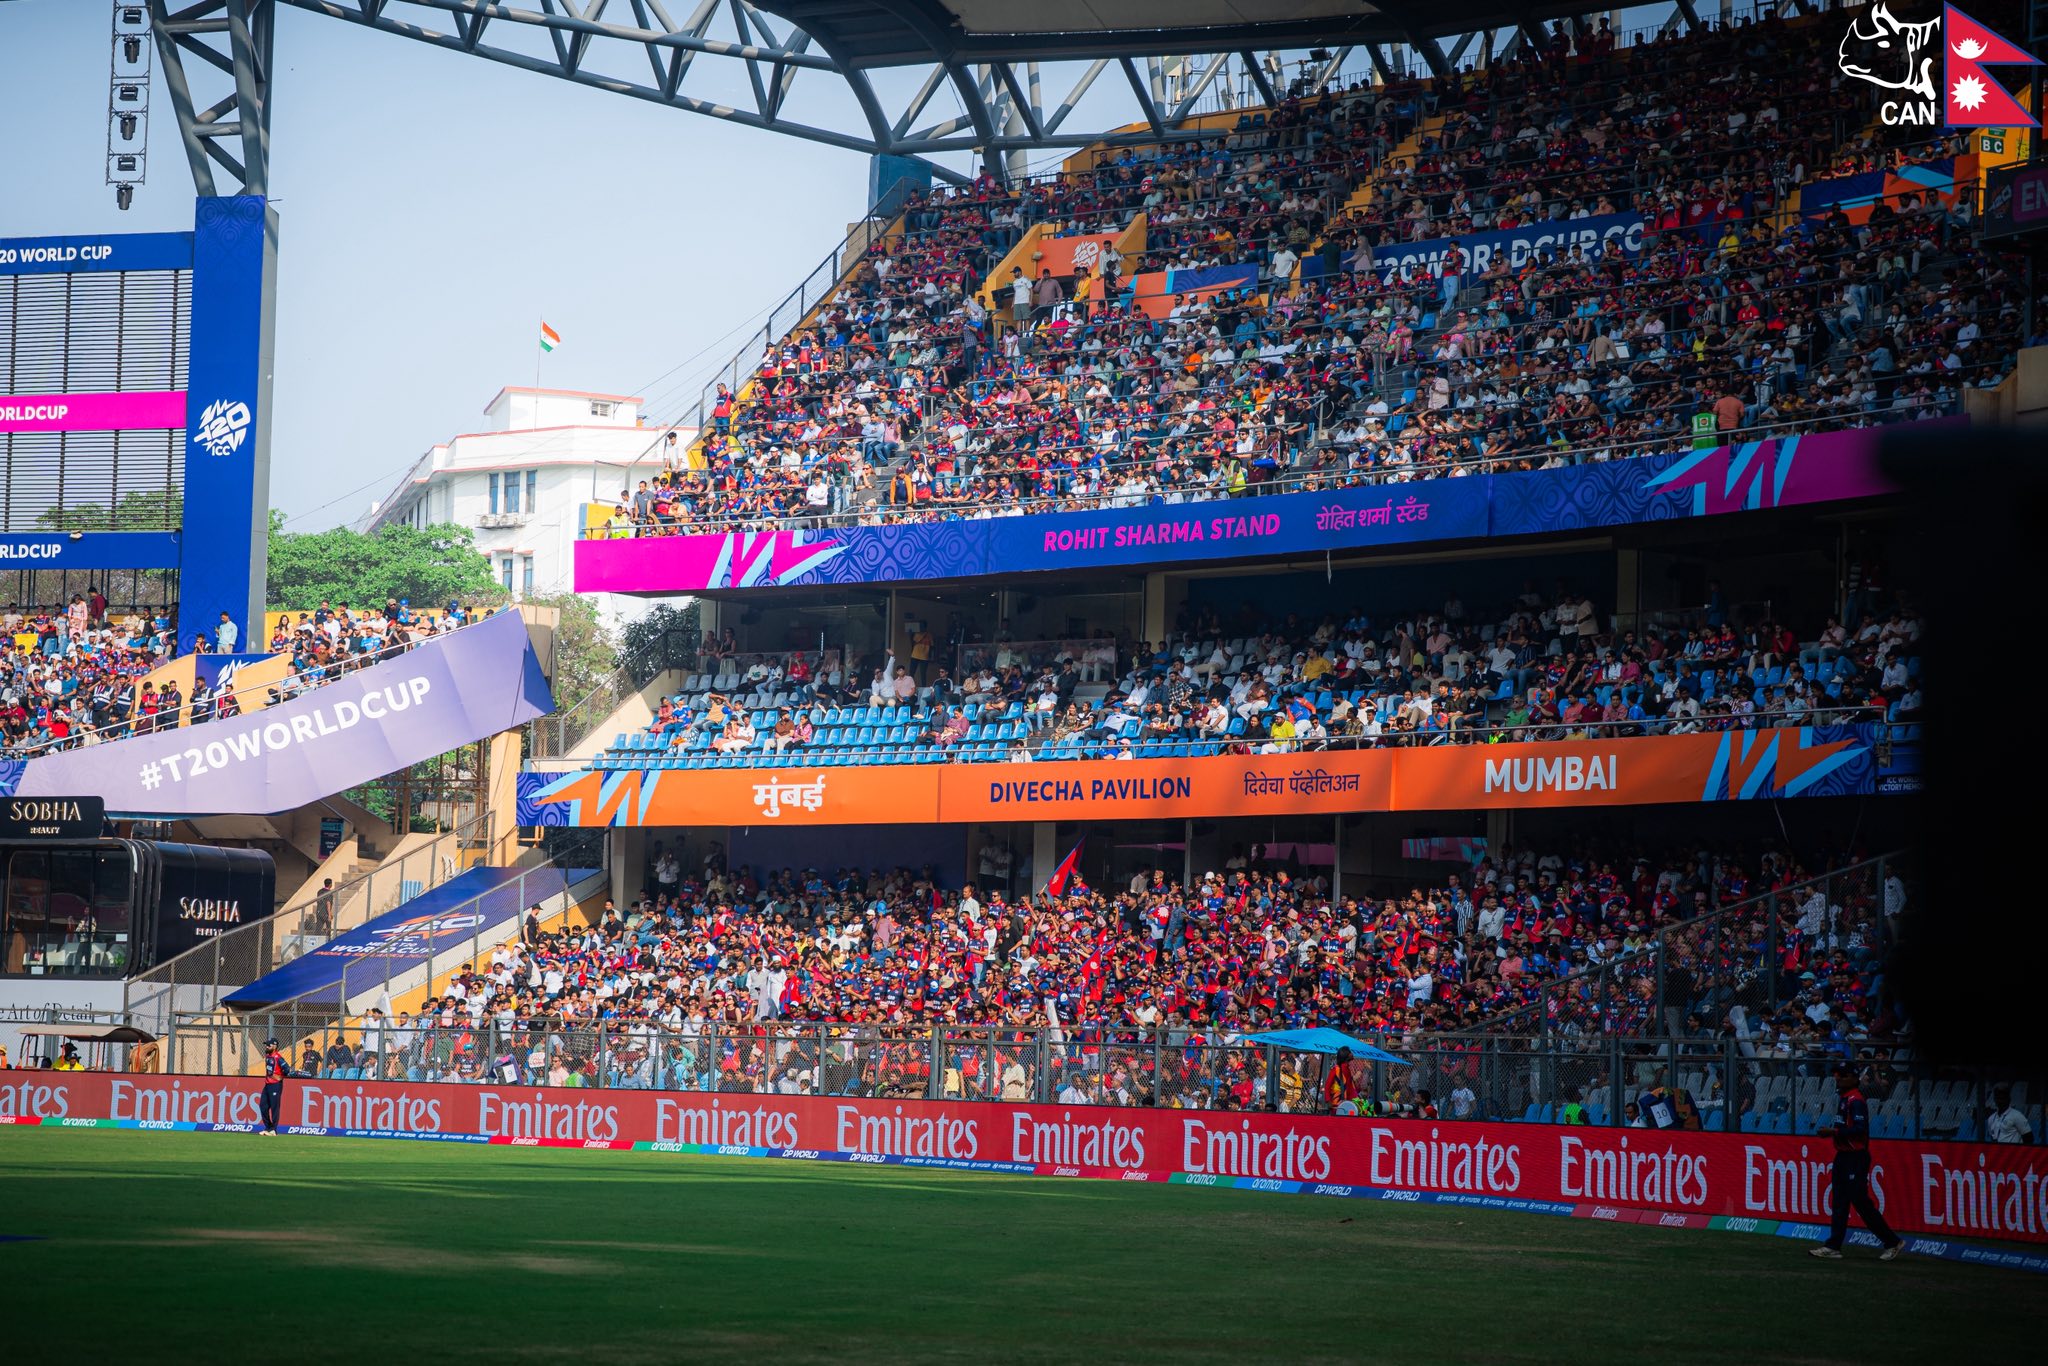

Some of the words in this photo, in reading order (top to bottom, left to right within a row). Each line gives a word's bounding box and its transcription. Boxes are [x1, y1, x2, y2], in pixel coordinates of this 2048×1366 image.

[1982, 139, 1990, 151] B
[1994, 140, 2002, 153] C
[20, 247, 76, 262] WORLD
[81, 246, 112, 260] CUP
[212, 446, 230, 456] ICC
[1316, 504, 1357, 531] रोहित
[1358, 498, 1392, 526] शर्मा
[1044, 528, 1109, 552] ROHIT
[1115, 520, 1204, 547] SHARMA
[1210, 514, 1280, 540] STAND
[139, 676, 430, 790] #T20WORLDCUP
[1484, 755, 1617, 793] MUMBAI
[991, 780, 1084, 803] DIVECHA
[1092, 777, 1191, 800] PAVILION
[1244, 771, 1284, 796] दिवेचा
[753, 774, 825, 817] मुंबई
[10, 801, 82, 822] SOBHA
[179, 896, 240, 922] SOBHA
[110, 1080, 261, 1124] Emirates
[301, 1086, 441, 1132] Emirates
[479, 1092, 618, 1141] Emirates
[1656, 1108, 1668, 1119] 10
[62, 1118, 97, 1126] aramco
[139, 1120, 174, 1130] aramco
[213, 1123, 226, 1131] DP
[226, 1124, 253, 1132] WORLD
[656, 1098, 798, 1149] Emirates
[288, 1126, 300, 1134] DP
[300, 1127, 327, 1135] WORLD
[836, 1105, 978, 1159] Emirates
[512, 1136, 539, 1146] Emirates
[584, 1139, 611, 1149] Emirates
[652, 1142, 682, 1152] aramco
[1012, 1111, 1144, 1169] Emirates
[718, 1146, 749, 1155] aramco
[782, 1150, 792, 1158] DP
[792, 1150, 818, 1159] WORLD
[1184, 1119, 1330, 1180] Emirates
[850, 1153, 861, 1162] DP
[860, 1154, 886, 1163] WORLD
[1370, 1128, 1520, 1192] Emirates
[1054, 1166, 1080, 1177] Emirates
[1122, 1170, 1150, 1181] Emirates
[1560, 1135, 1708, 1206] Emirates
[1186, 1173, 1216, 1185] aramco
[1252, 1178, 1282, 1190] aramco
[1315, 1184, 1326, 1194] DP
[1325, 1185, 1352, 1196] WORLD
[1382, 1189, 1394, 1199] DP
[1392, 1190, 1420, 1201] WORLD
[1592, 1206, 1618, 1220] Emirates
[1659, 1212, 1688, 1227] Emirates
[1726, 1217, 1758, 1232] aramco
[1791, 1224, 1822, 1240] aramco
[1912, 1240, 1924, 1253] DP
[1922, 1240, 1948, 1256] WORLD
